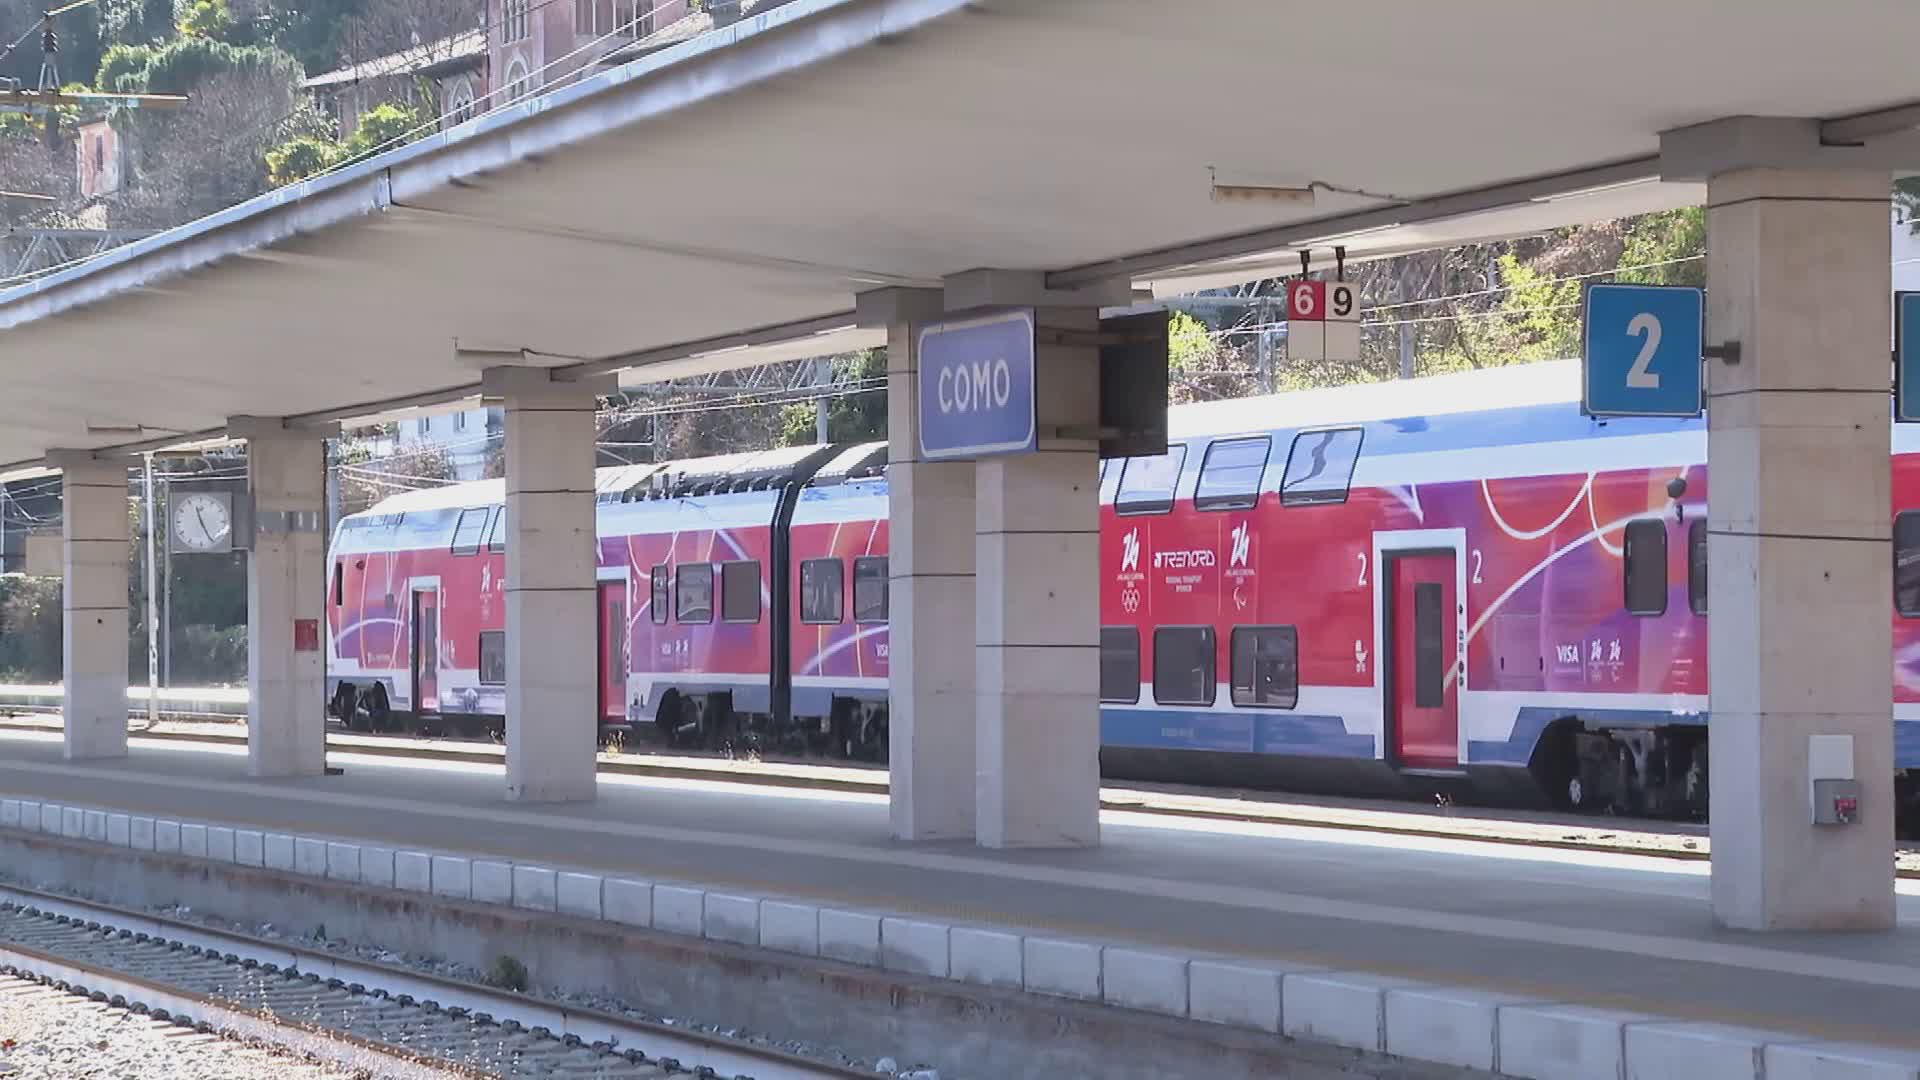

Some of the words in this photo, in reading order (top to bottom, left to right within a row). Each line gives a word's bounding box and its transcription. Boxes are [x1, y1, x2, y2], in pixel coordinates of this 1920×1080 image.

[1294, 284, 1314, 315] 6
[1333, 286, 1353, 316] 9
[1626, 312, 1662, 388] 2
[938, 358, 1010, 413] COMO
[1161, 549, 1216, 568] TRENORD
[1357, 552, 1368, 586] 2
[1472, 549, 1483, 584] 2
[1556, 645, 1579, 663] VISA
